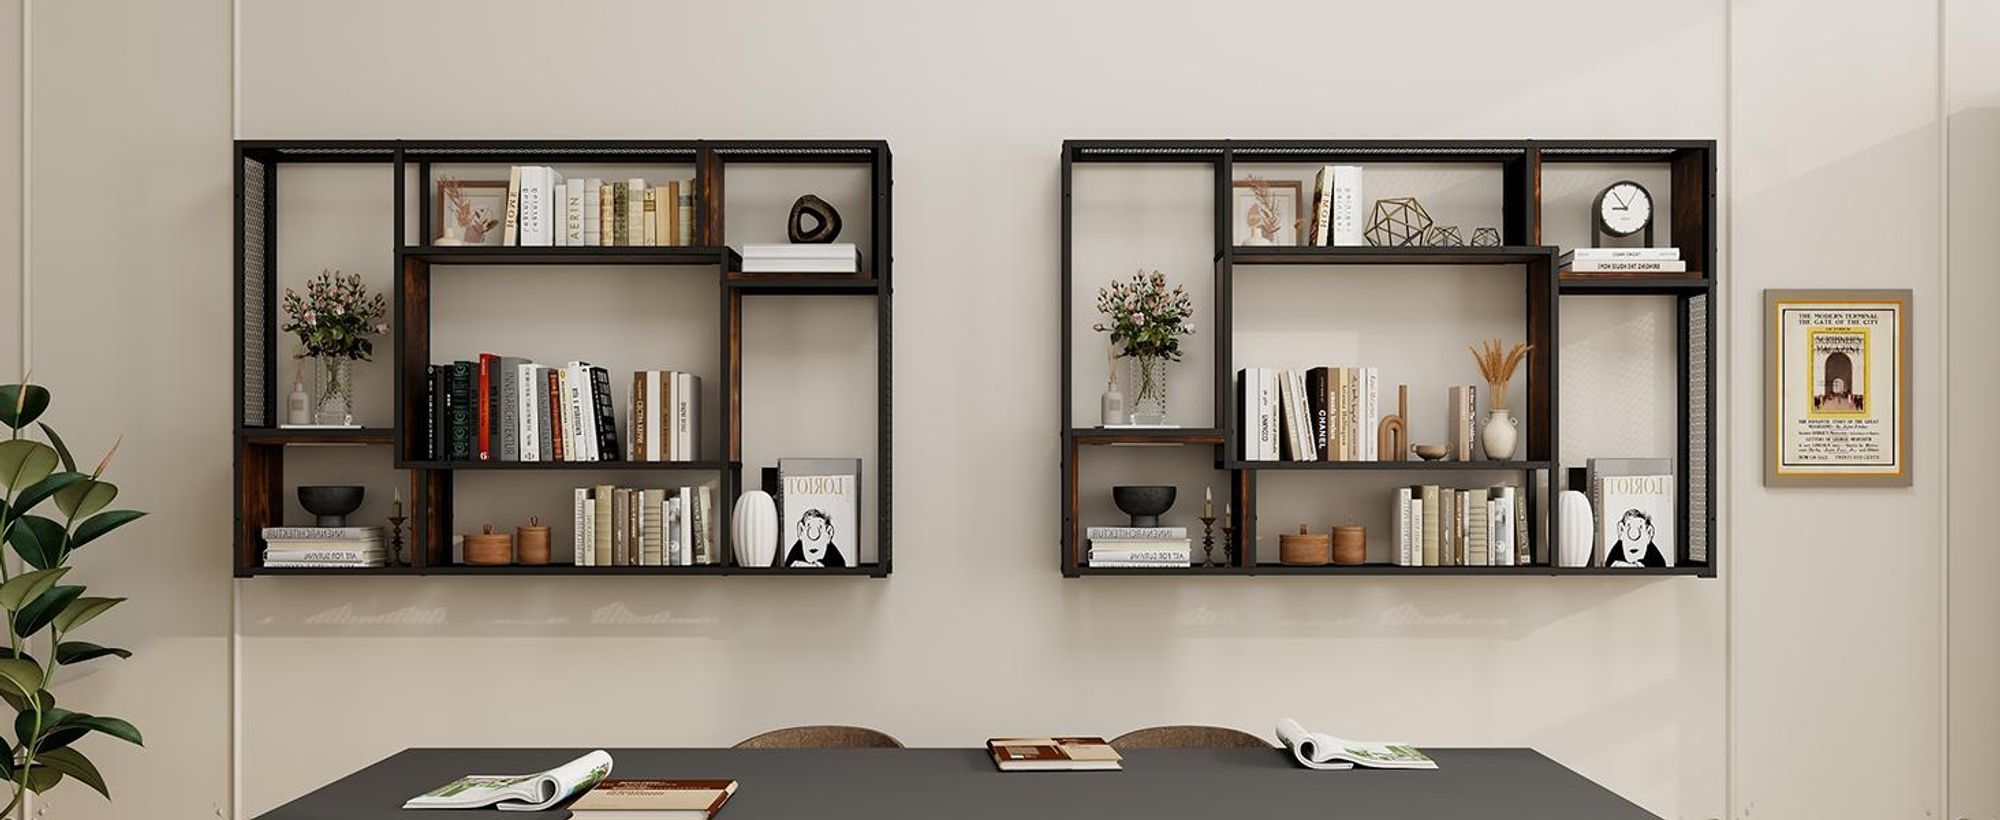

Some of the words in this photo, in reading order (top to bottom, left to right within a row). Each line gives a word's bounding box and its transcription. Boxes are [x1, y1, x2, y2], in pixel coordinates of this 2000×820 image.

[507, 191, 517, 228] HOME
[570, 197, 580, 239] AERIN
[1320, 193, 1330, 228] HOME
[1318, 409, 1327, 449] CHANEL
